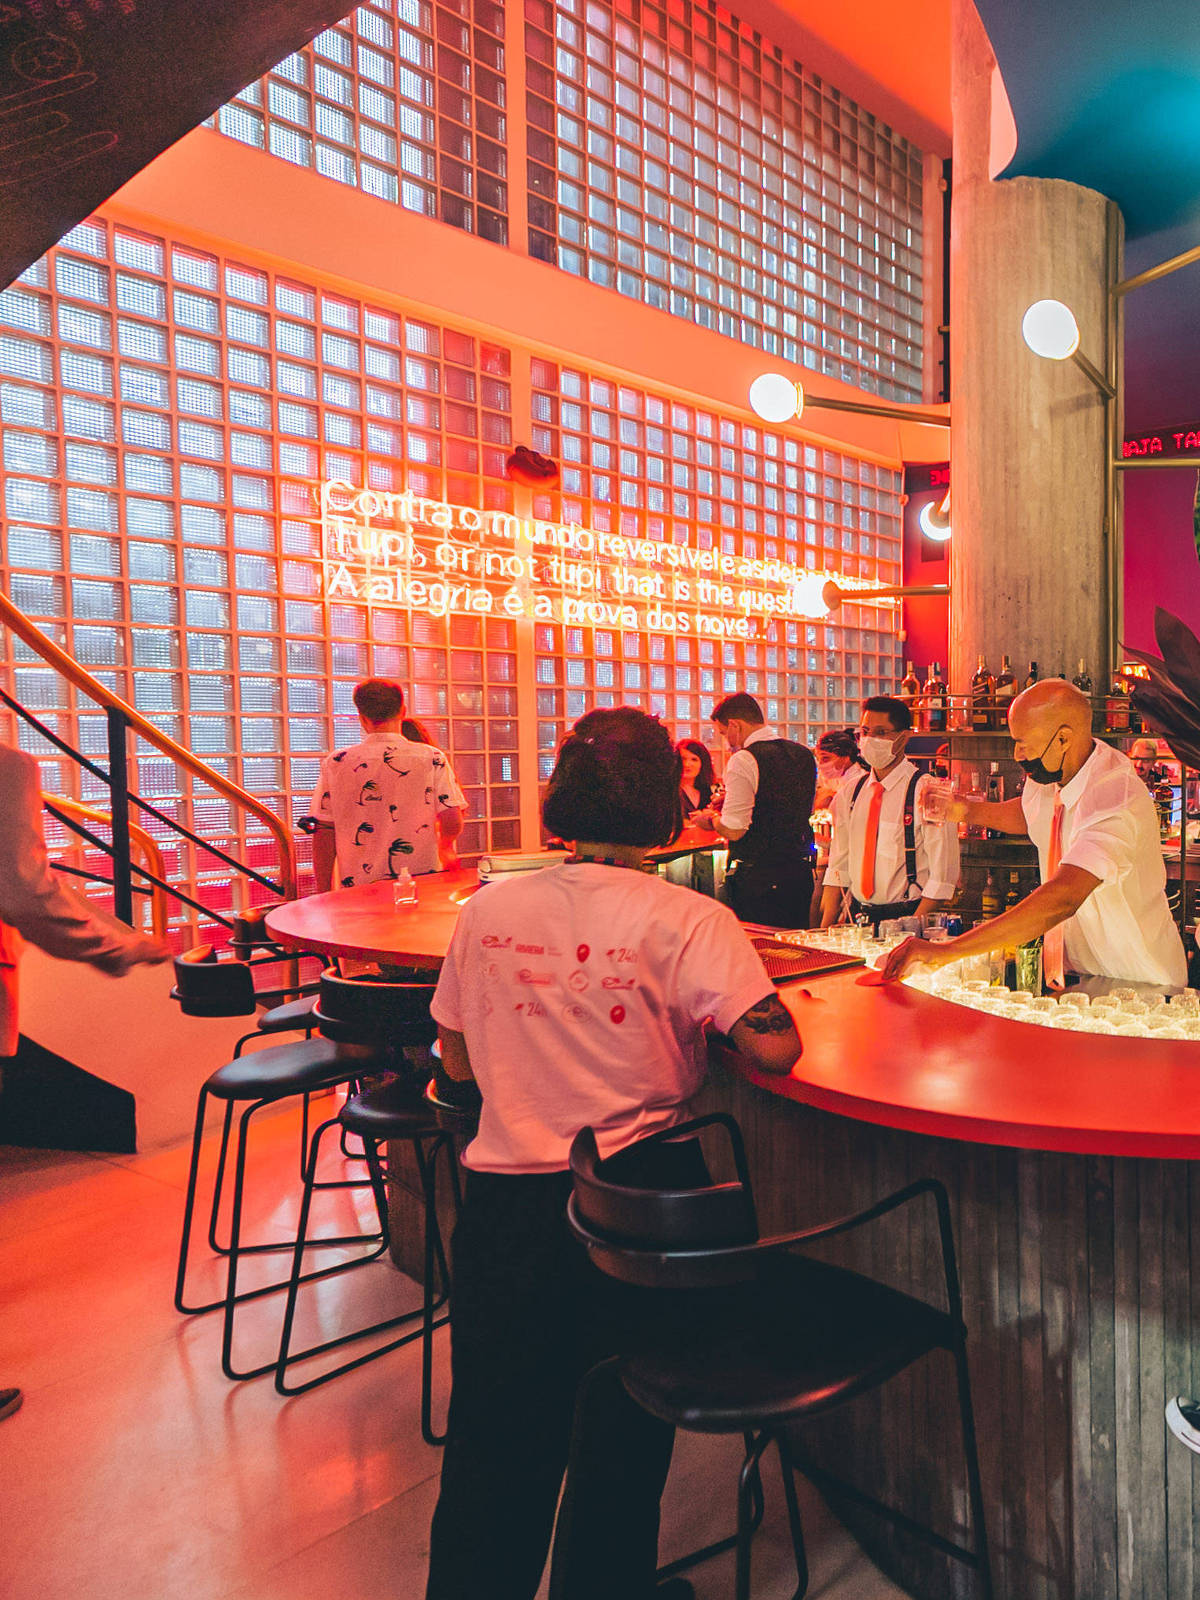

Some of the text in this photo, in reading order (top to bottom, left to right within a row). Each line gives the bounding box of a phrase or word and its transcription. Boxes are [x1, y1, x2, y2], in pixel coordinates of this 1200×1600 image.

[324, 478, 452, 527] Contra
[459, 508, 481, 531] o
[492, 511, 594, 552] mundo
[328, 563, 358, 597] A
[369, 569, 493, 617] alegria
[503, 587, 524, 616] é
[534, 594, 552, 618] a
[563, 597, 638, 628] prova
[646, 602, 690, 632] dos
[436, 543, 475, 571] or
[486, 551, 540, 582] not
[550, 555, 601, 595] tupi
[612, 568, 666, 600] that
[674, 572, 690, 601] is
[696, 577, 734, 606] the
